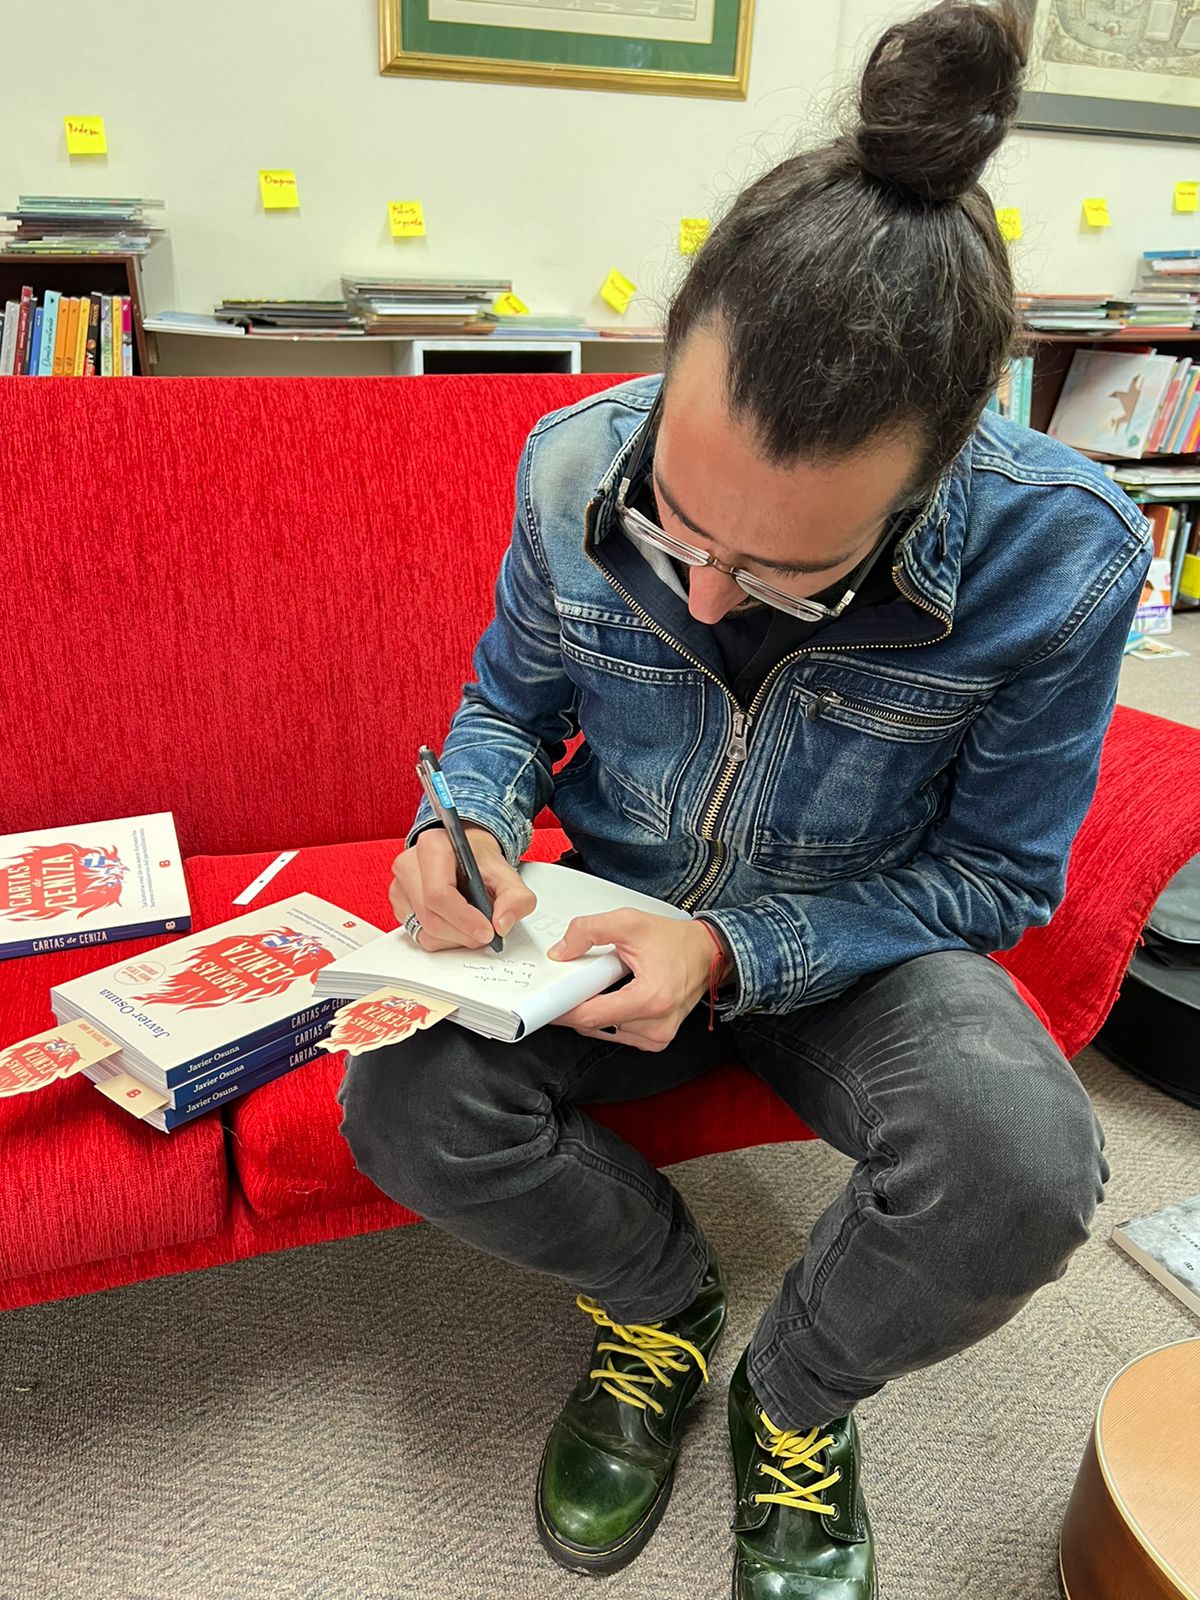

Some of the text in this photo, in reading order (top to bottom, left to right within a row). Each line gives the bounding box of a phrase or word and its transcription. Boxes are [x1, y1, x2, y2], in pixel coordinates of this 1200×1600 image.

[7, 865, 33, 908] CARTAS
[41, 853, 78, 908] CENIZA
[32, 931, 108, 952] CARTAS de CENIZA
[219, 942, 295, 984] CENIZA
[191, 961, 249, 995] CARTAS
[99, 988, 135, 1014] Osuna
[131, 1012, 170, 1039] Javier
[291, 1007, 320, 1029] CARTAS
[321, 1004, 331, 1013] de
[350, 1016, 388, 1035] CARTAS
[362, 1005, 411, 1028] CENIZA
[294, 1024, 322, 1046] CARTAS
[22, 1046, 58, 1075] CENIZA
[187, 1045, 240, 1073] Javier Osuna
[289, 1045, 318, 1067] CARTAS
[193, 1064, 245, 1093] Javier Osuna
[185, 1084, 239, 1114] Javier Osuna
